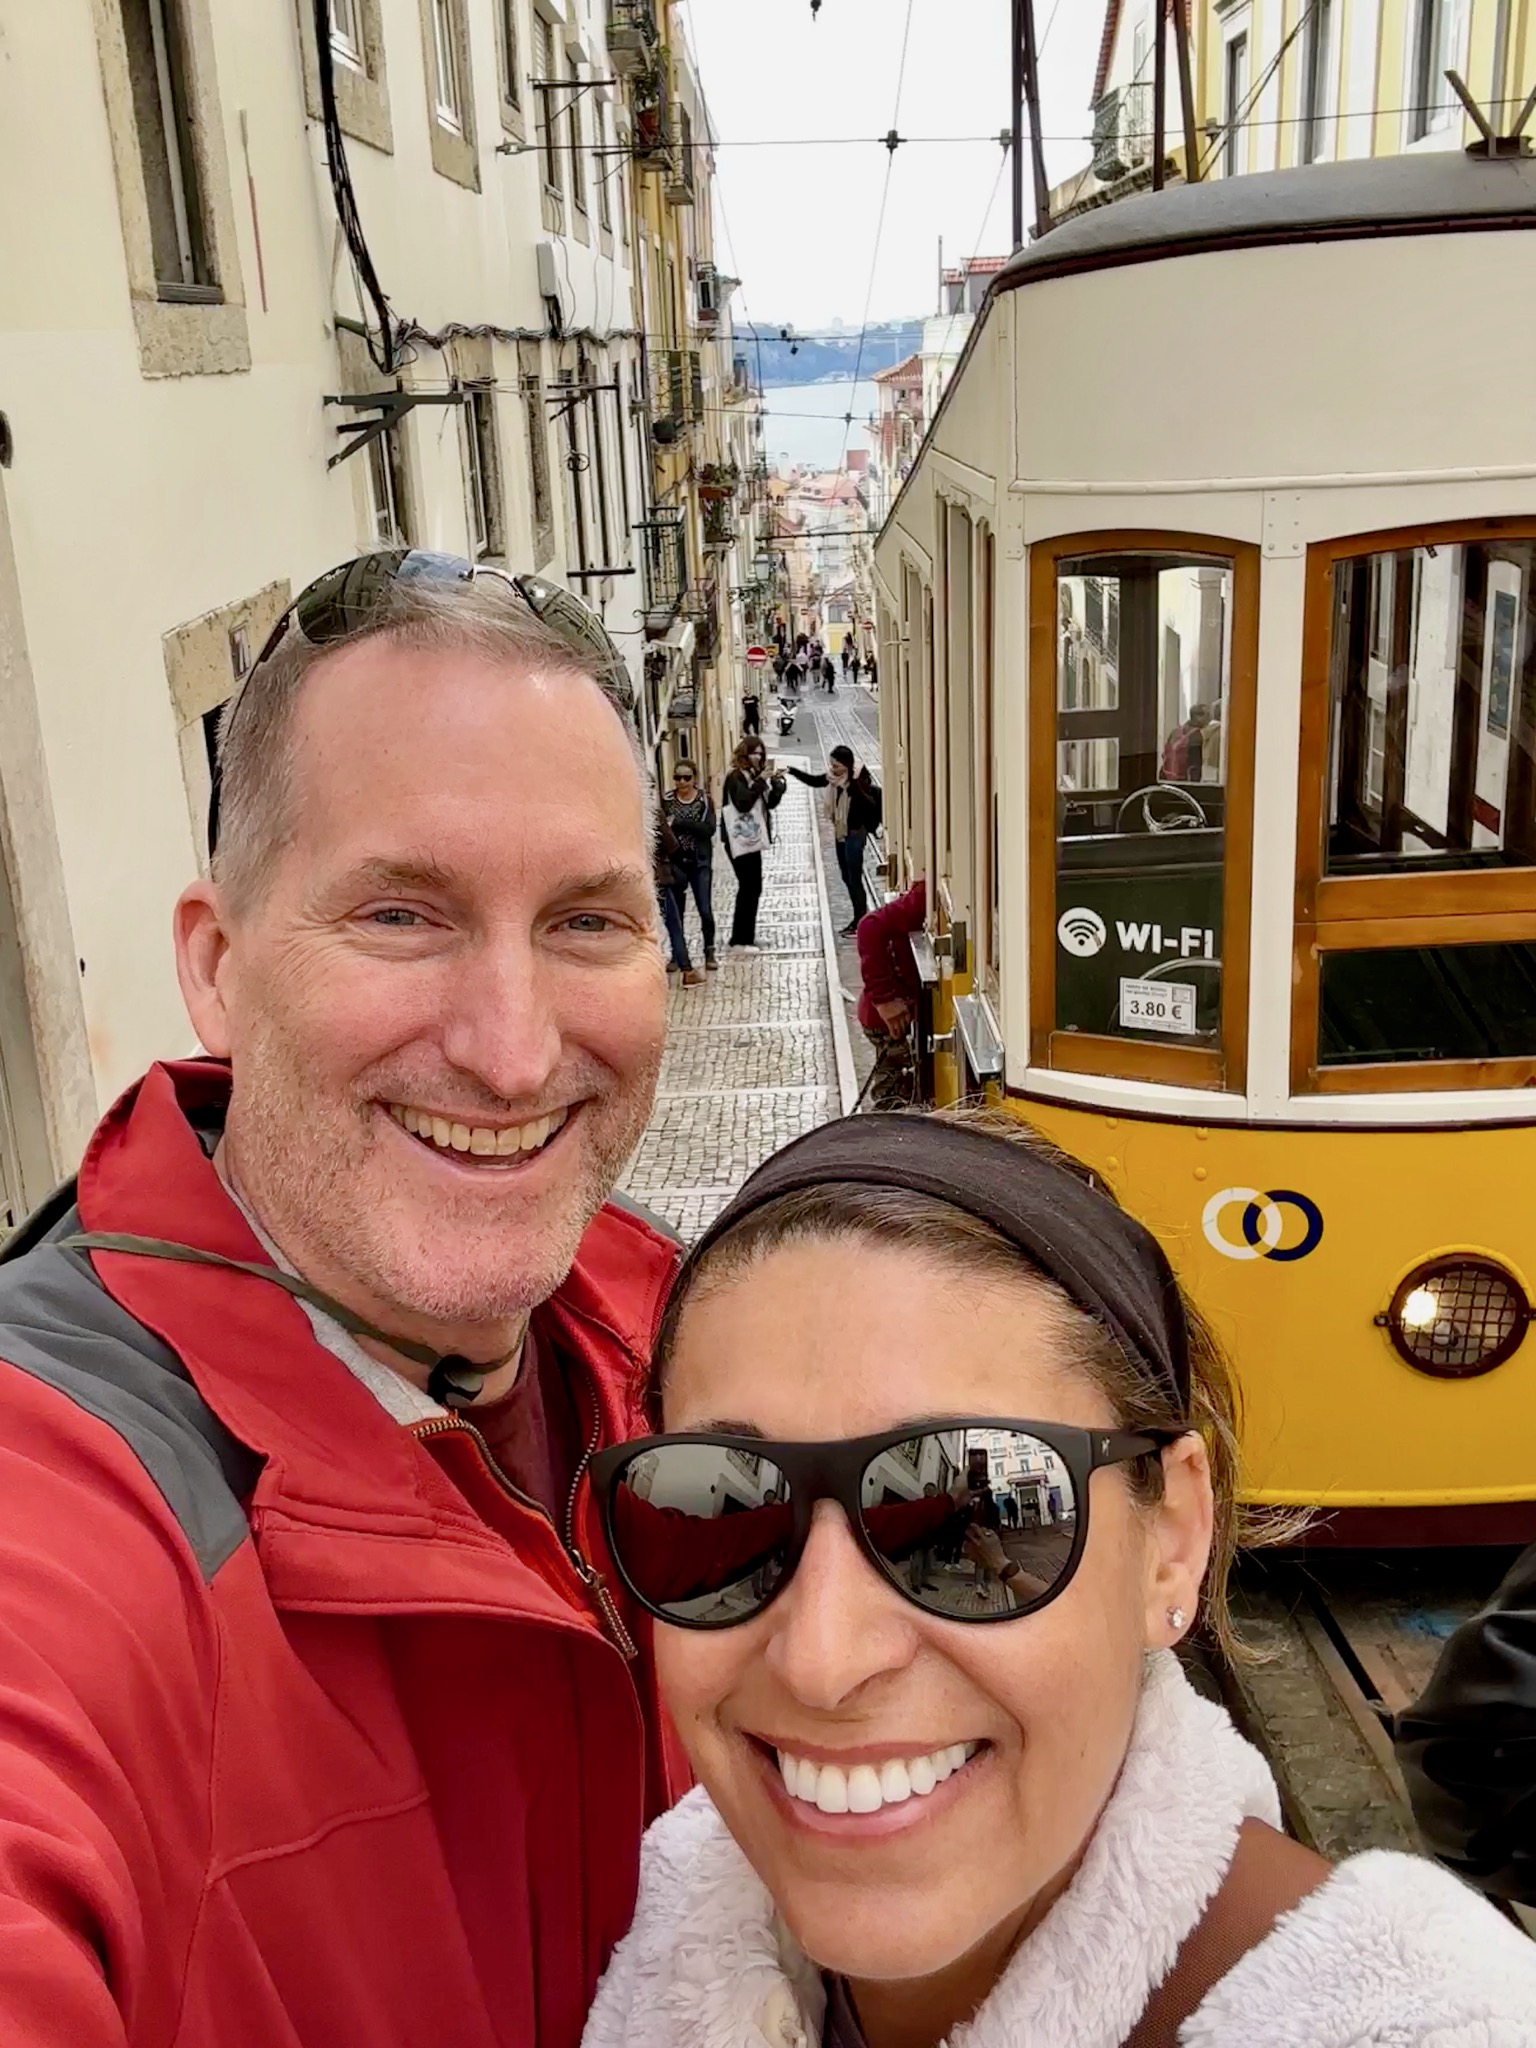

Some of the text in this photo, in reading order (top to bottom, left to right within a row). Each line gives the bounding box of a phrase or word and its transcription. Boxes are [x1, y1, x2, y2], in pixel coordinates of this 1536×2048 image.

[1115, 921, 1214, 959] WI-FI
[1130, 1000, 1182, 1020] 3.80 €
